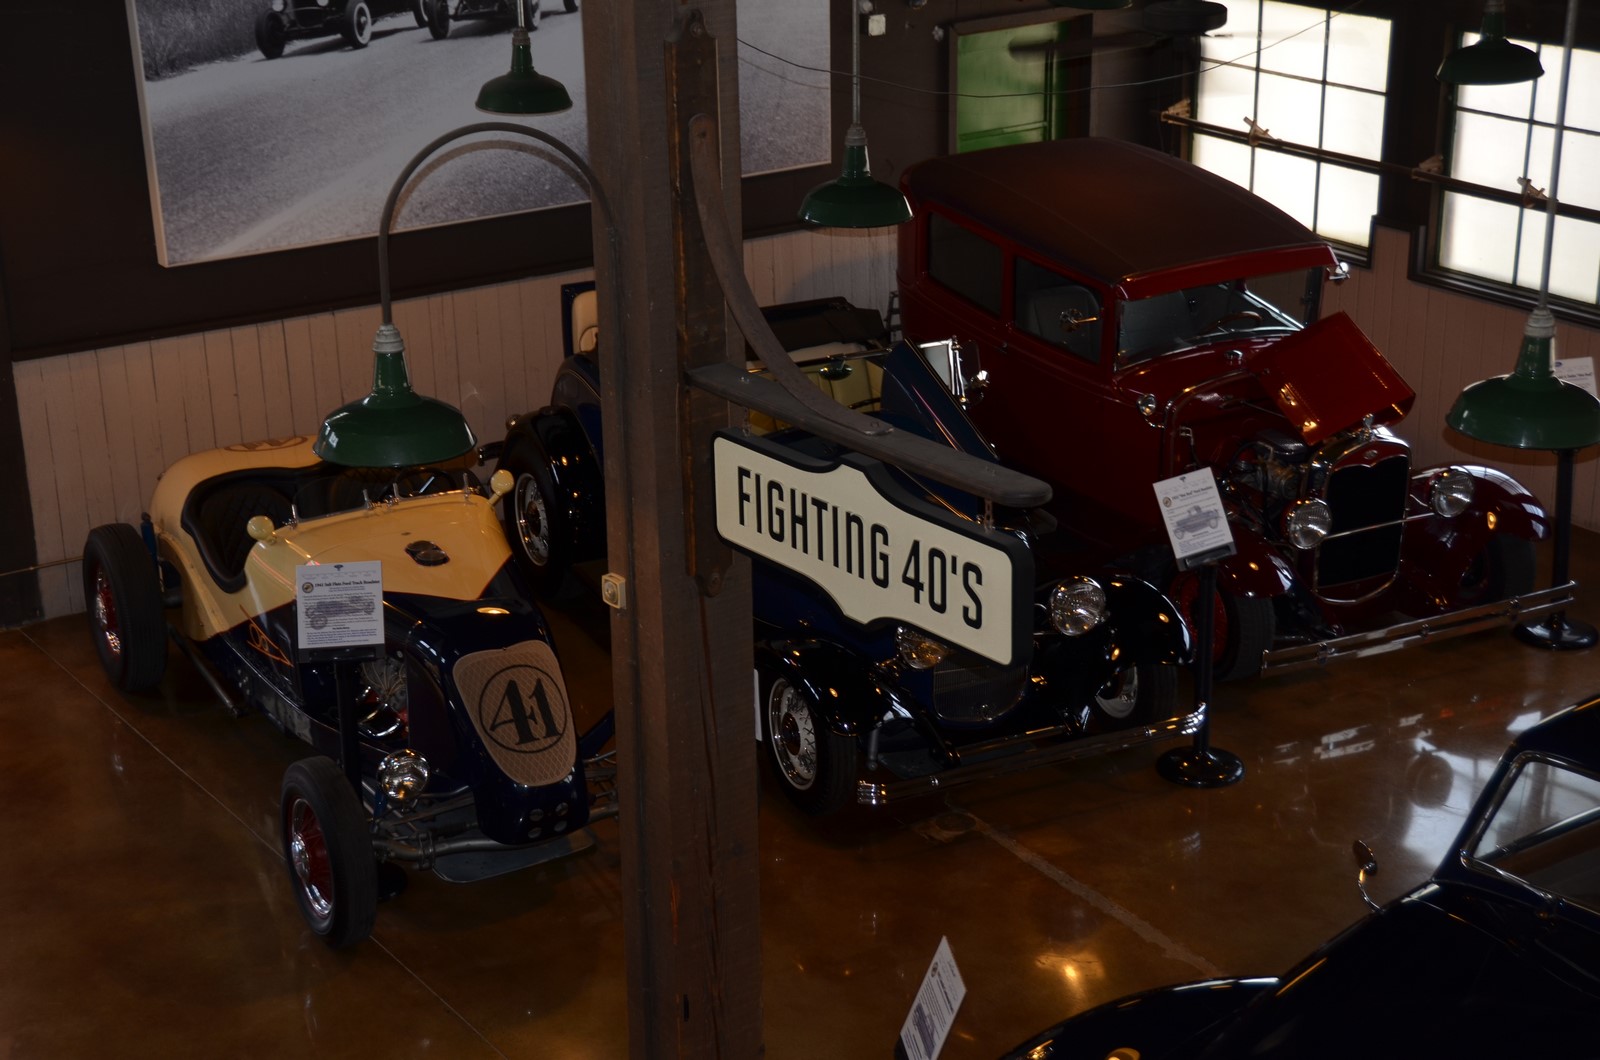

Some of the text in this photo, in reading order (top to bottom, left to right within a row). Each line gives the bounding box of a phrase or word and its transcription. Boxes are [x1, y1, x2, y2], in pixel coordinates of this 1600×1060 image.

[737, 465, 984, 631] FIGHTING 40'S
[489, 678, 562, 745] 41
